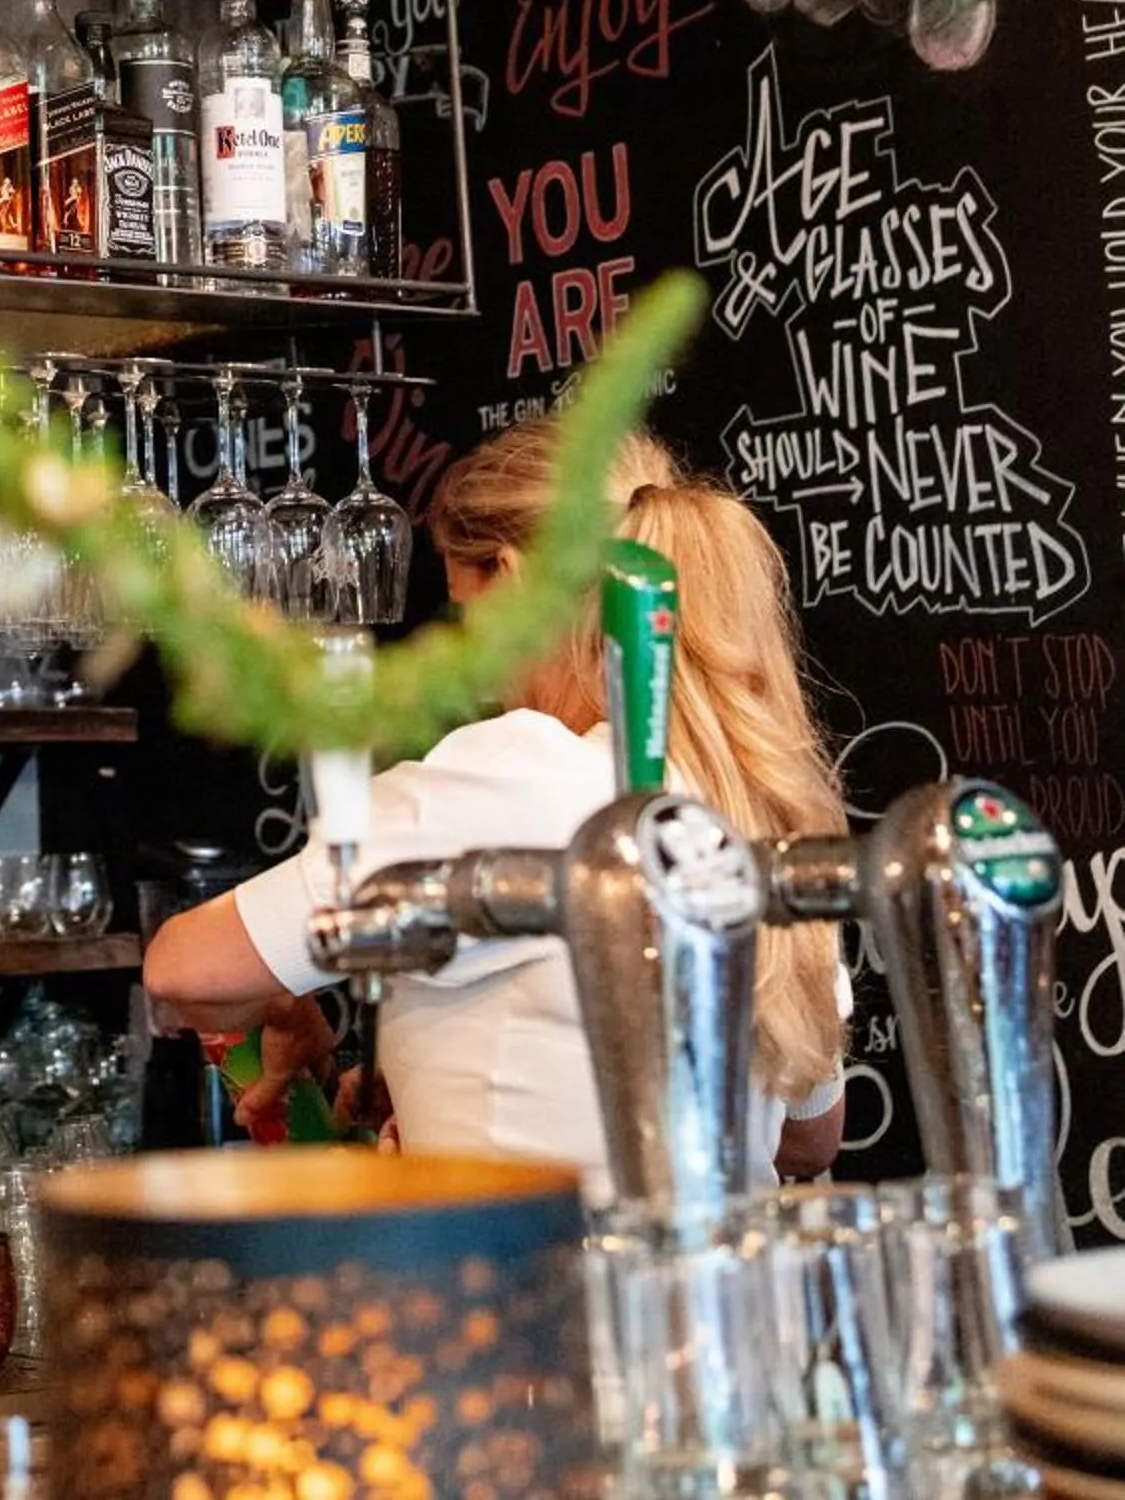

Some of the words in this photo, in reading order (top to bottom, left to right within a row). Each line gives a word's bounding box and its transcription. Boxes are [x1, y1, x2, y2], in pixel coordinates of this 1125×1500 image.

[72, 107, 96, 122] LABE
[488, 142, 632, 266] YOU
[701, 75, 885, 266] AGE
[724, 251, 778, 329] &
[804, 193, 995, 303] GLASSES
[507, 256, 636, 379] ARE
[475, 401, 510, 432] THE
[513, 395, 545, 423] GIN
[644, 368, 678, 399] NIC
[797, 322, 960, 429] WINE
[736, 426, 861, 485] SHOULD
[867, 414, 1051, 514] NEVER
[810, 519, 853, 579] BE
[864, 514, 1075, 601] COUNTED
[939, 631, 1031, 697] DON'T
[1042, 631, 1117, 712] STOP
[1039, 700, 1099, 767] YOU
